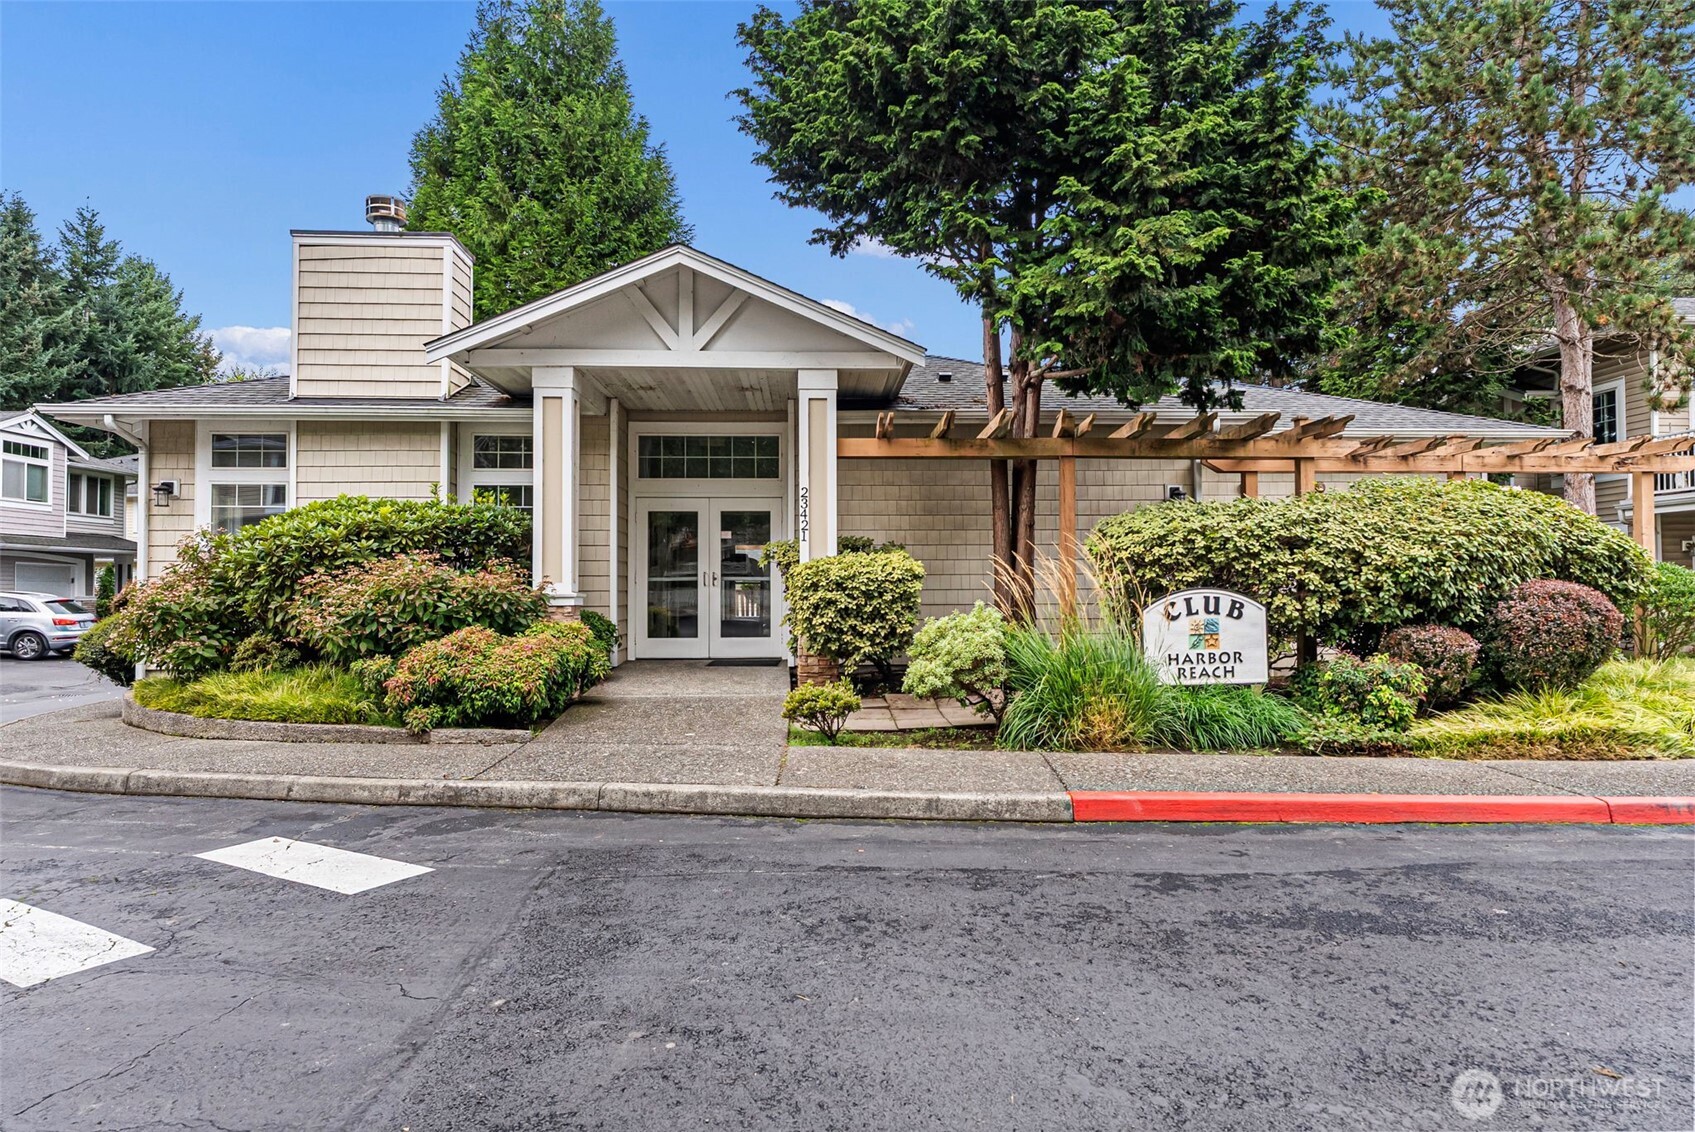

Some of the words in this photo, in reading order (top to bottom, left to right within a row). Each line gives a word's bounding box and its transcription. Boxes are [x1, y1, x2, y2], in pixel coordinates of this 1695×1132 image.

[800, 487, 809, 542] 23421
[1164, 595, 1245, 621] CLUB
[1168, 651, 1243, 666] HARBOR
[1177, 666, 1235, 679] REACH
